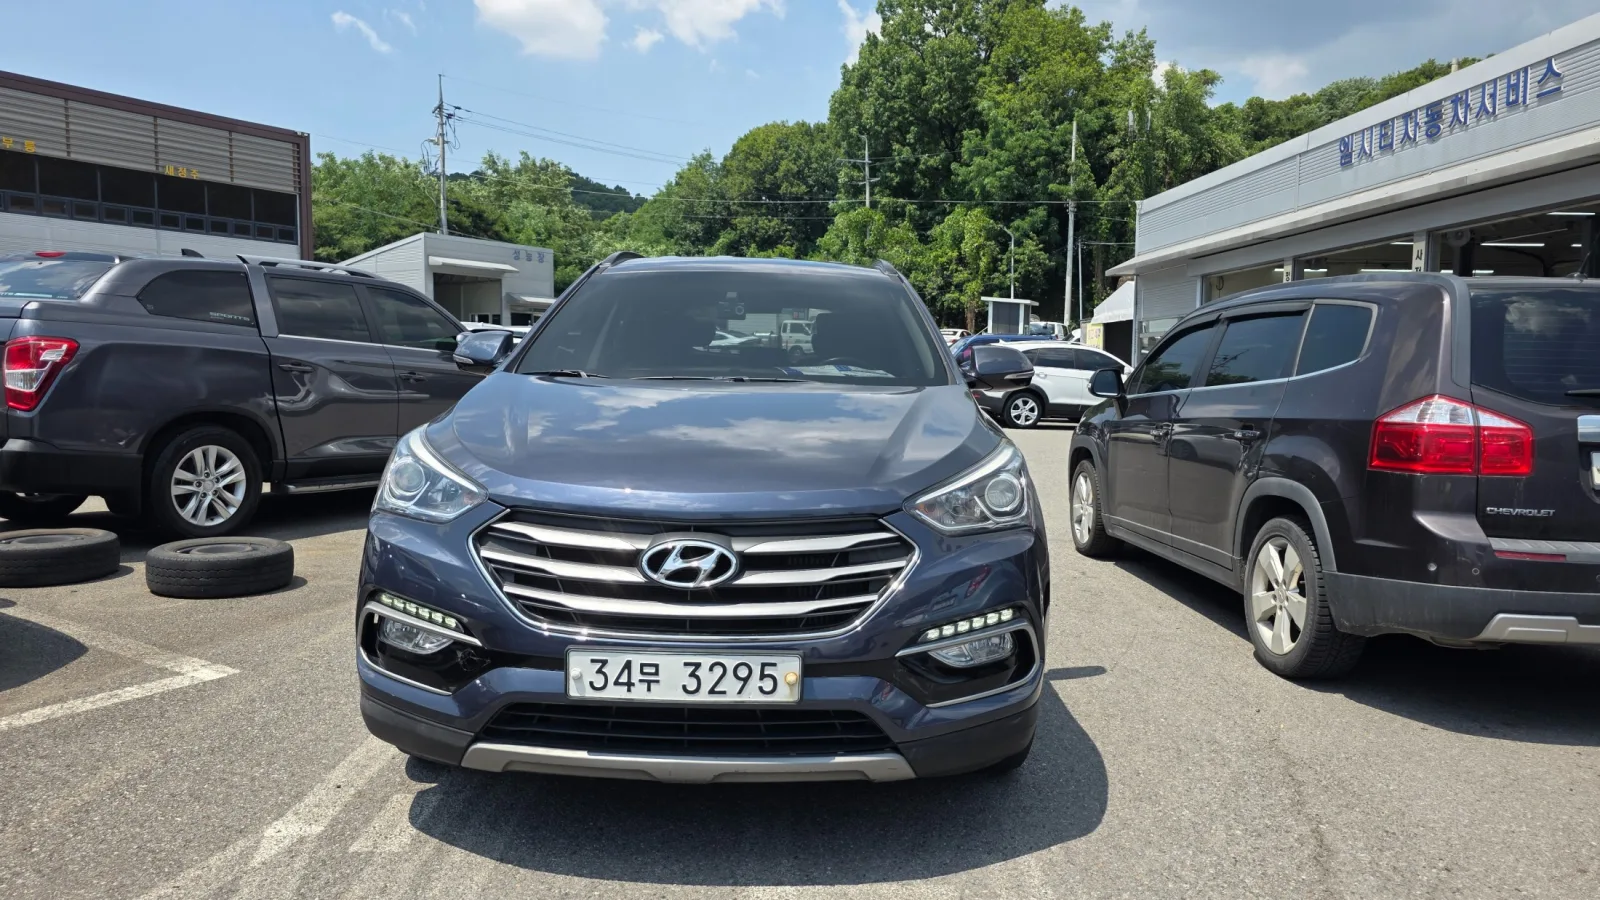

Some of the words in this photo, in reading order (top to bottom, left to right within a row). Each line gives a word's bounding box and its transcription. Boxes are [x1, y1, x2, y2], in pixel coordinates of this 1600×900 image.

[1486, 506, 1555, 517] CHEVROLET
[588, 658, 661, 693] 34무
[681, 661, 778, 695] 3295
